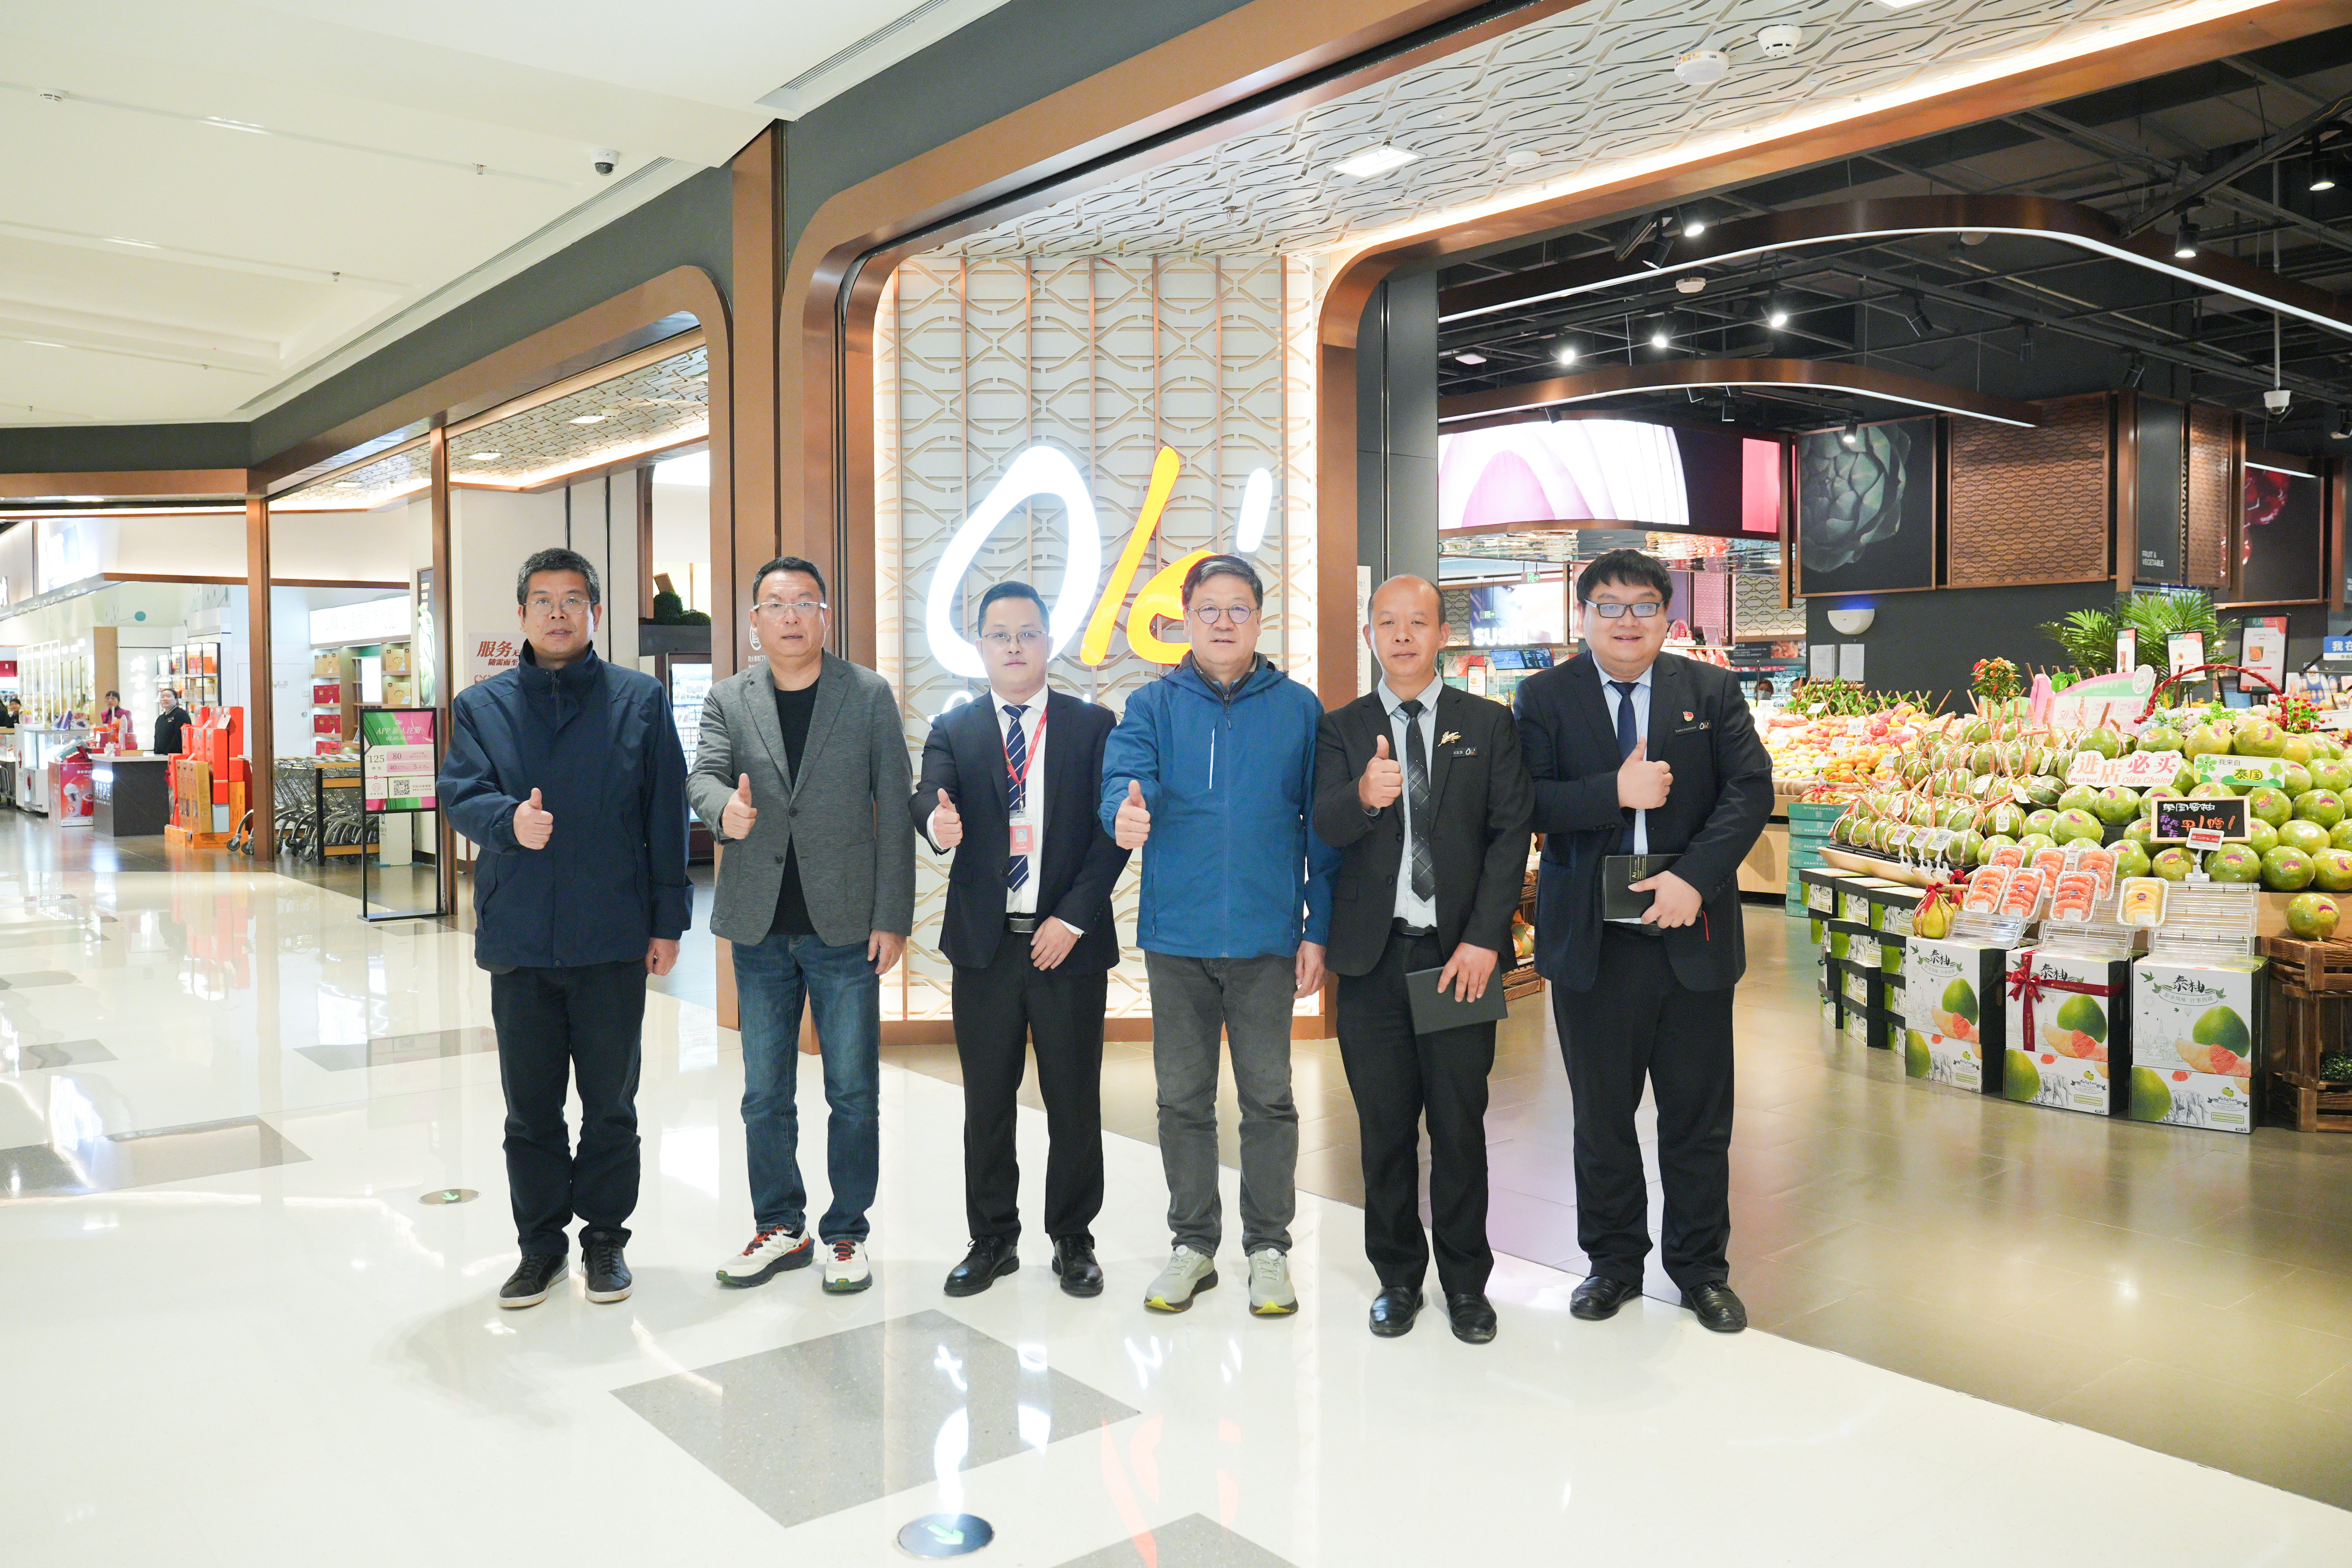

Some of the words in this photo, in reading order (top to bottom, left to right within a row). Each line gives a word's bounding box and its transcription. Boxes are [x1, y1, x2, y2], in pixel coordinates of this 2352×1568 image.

[2142, 558, 2164, 567] VEGETABLE
[1473, 628, 1528, 646] SUSHI
[2077, 754, 2177, 783] 进店必买
[2234, 768, 2263, 780] 泰国
[1930, 949, 1950, 966] 泰柚
[2039, 963, 2068, 981] 泰柚
[2172, 975, 2205, 993] 泰柚
